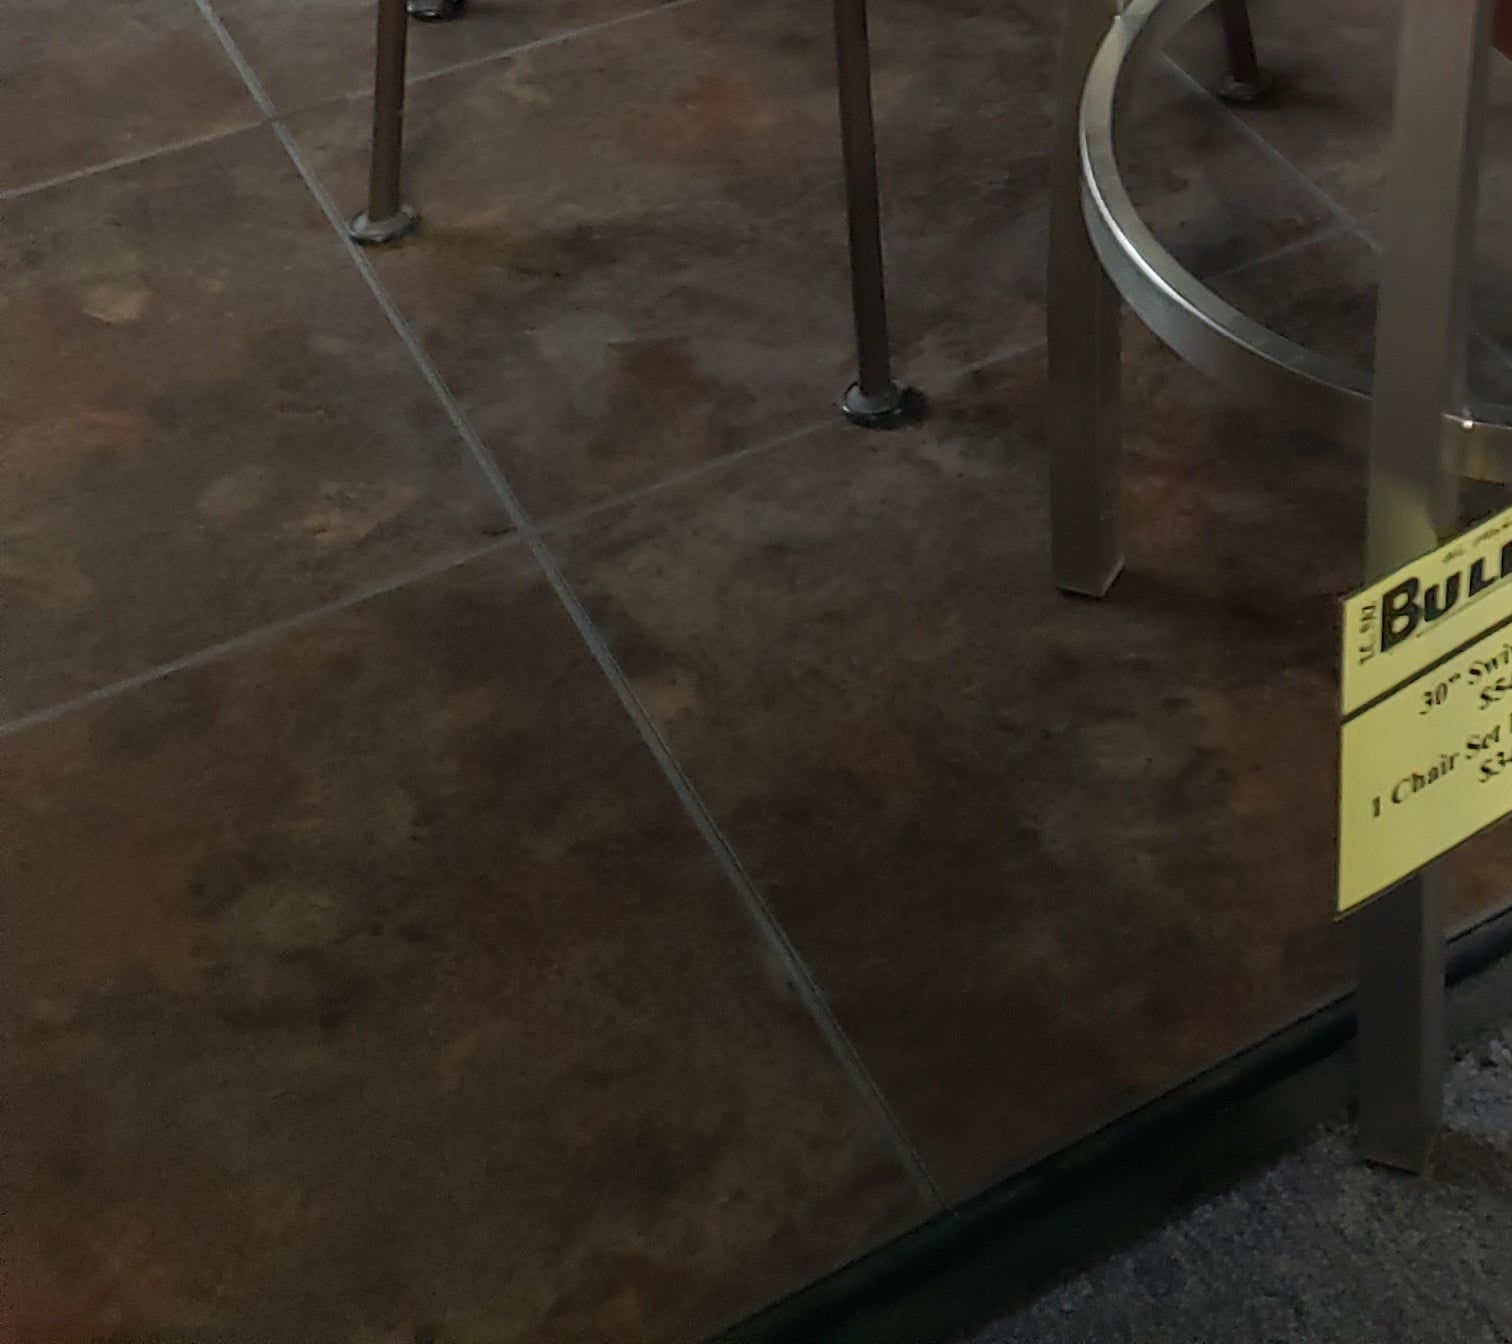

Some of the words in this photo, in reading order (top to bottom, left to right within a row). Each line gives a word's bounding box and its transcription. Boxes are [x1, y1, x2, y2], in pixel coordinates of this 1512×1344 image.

[1372, 796, 1381, 818] 1
[1391, 752, 1460, 805] Chair
[1465, 725, 1501, 759] Set
